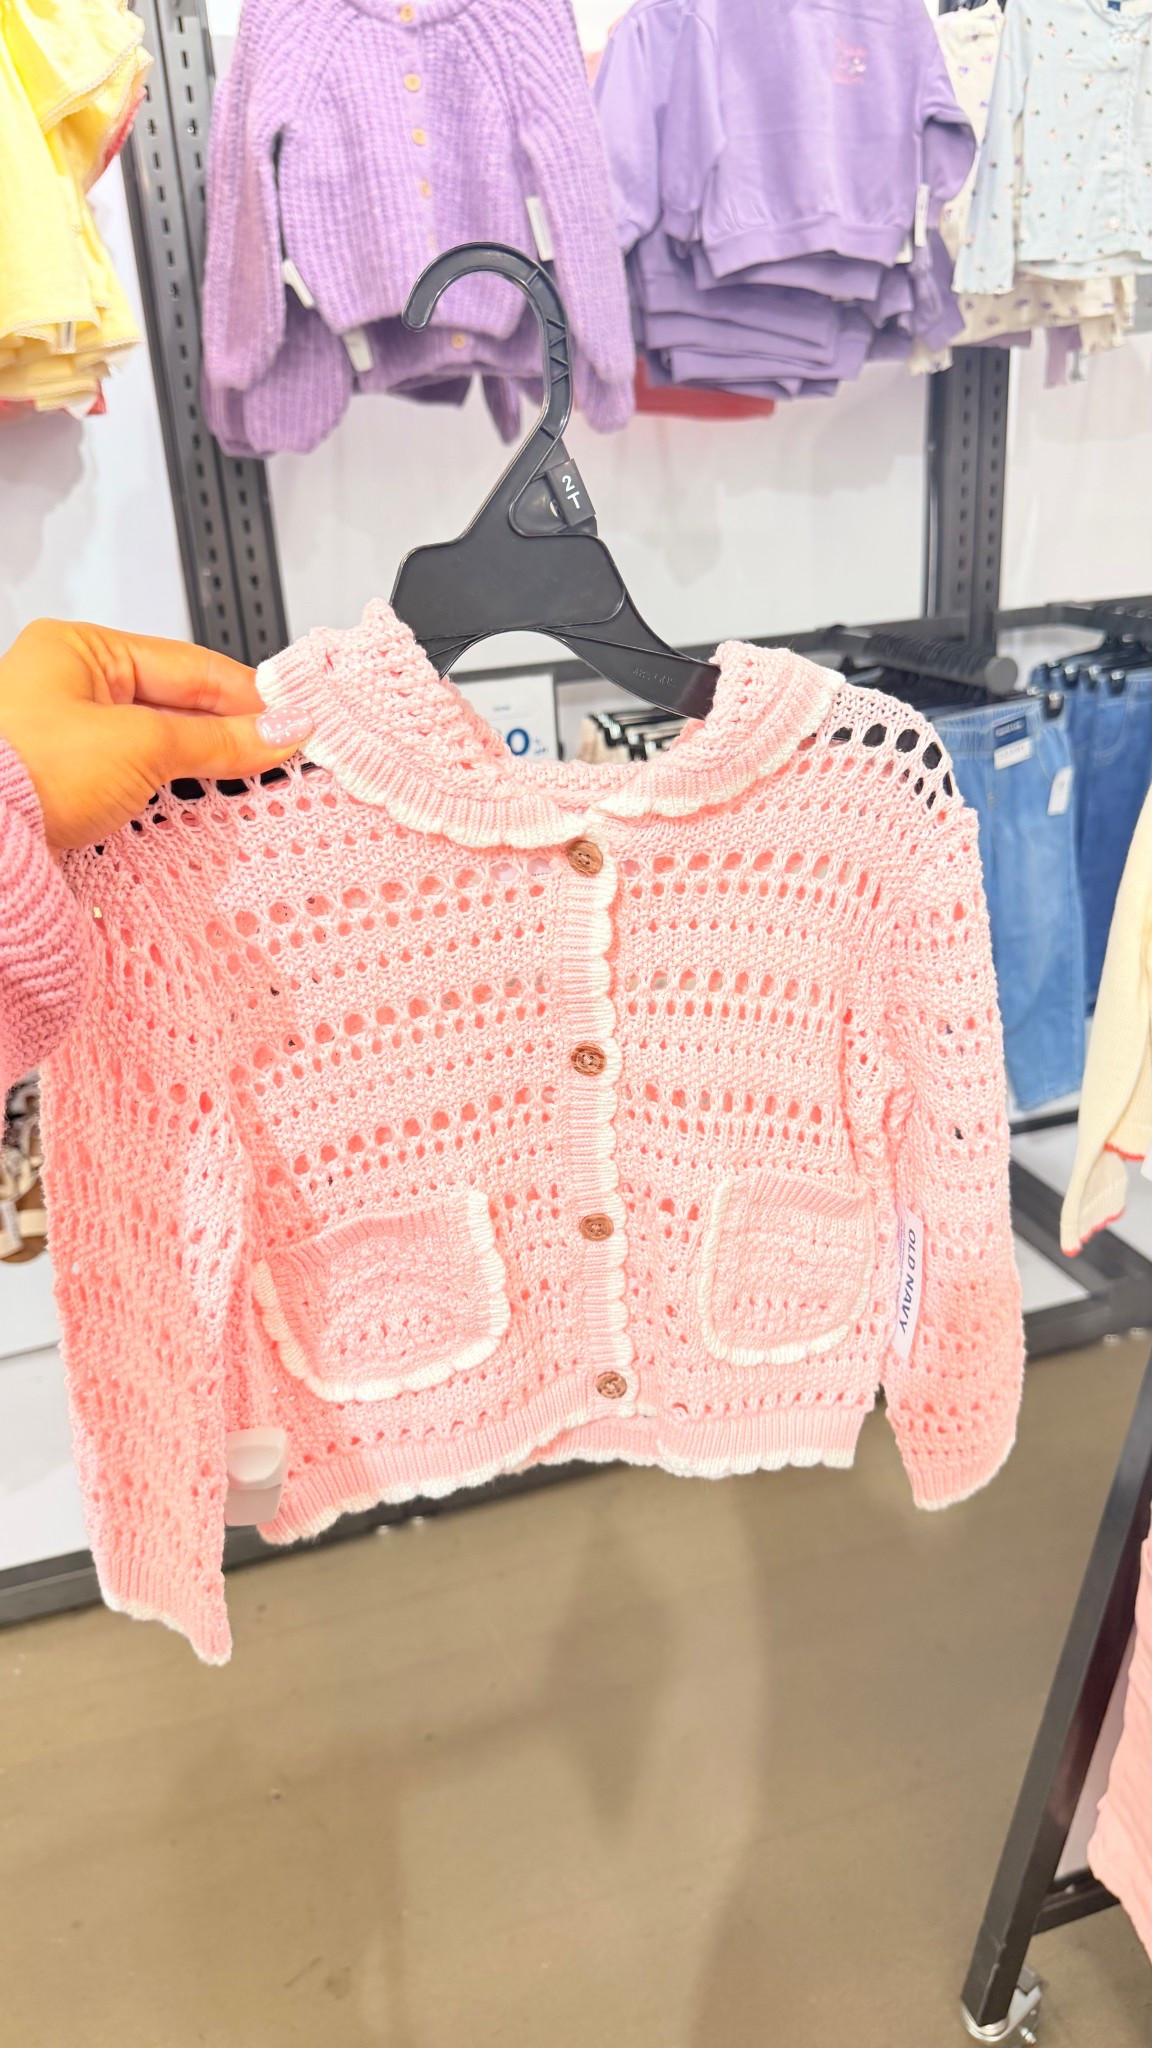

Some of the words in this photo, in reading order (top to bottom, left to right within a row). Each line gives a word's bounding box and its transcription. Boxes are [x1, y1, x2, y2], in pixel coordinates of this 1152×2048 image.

[561, 475, 581, 509] 2T
[501, 728, 529, 756] 0
[907, 1228, 916, 1271] OLD
[899, 1273, 914, 1334] NAVY
